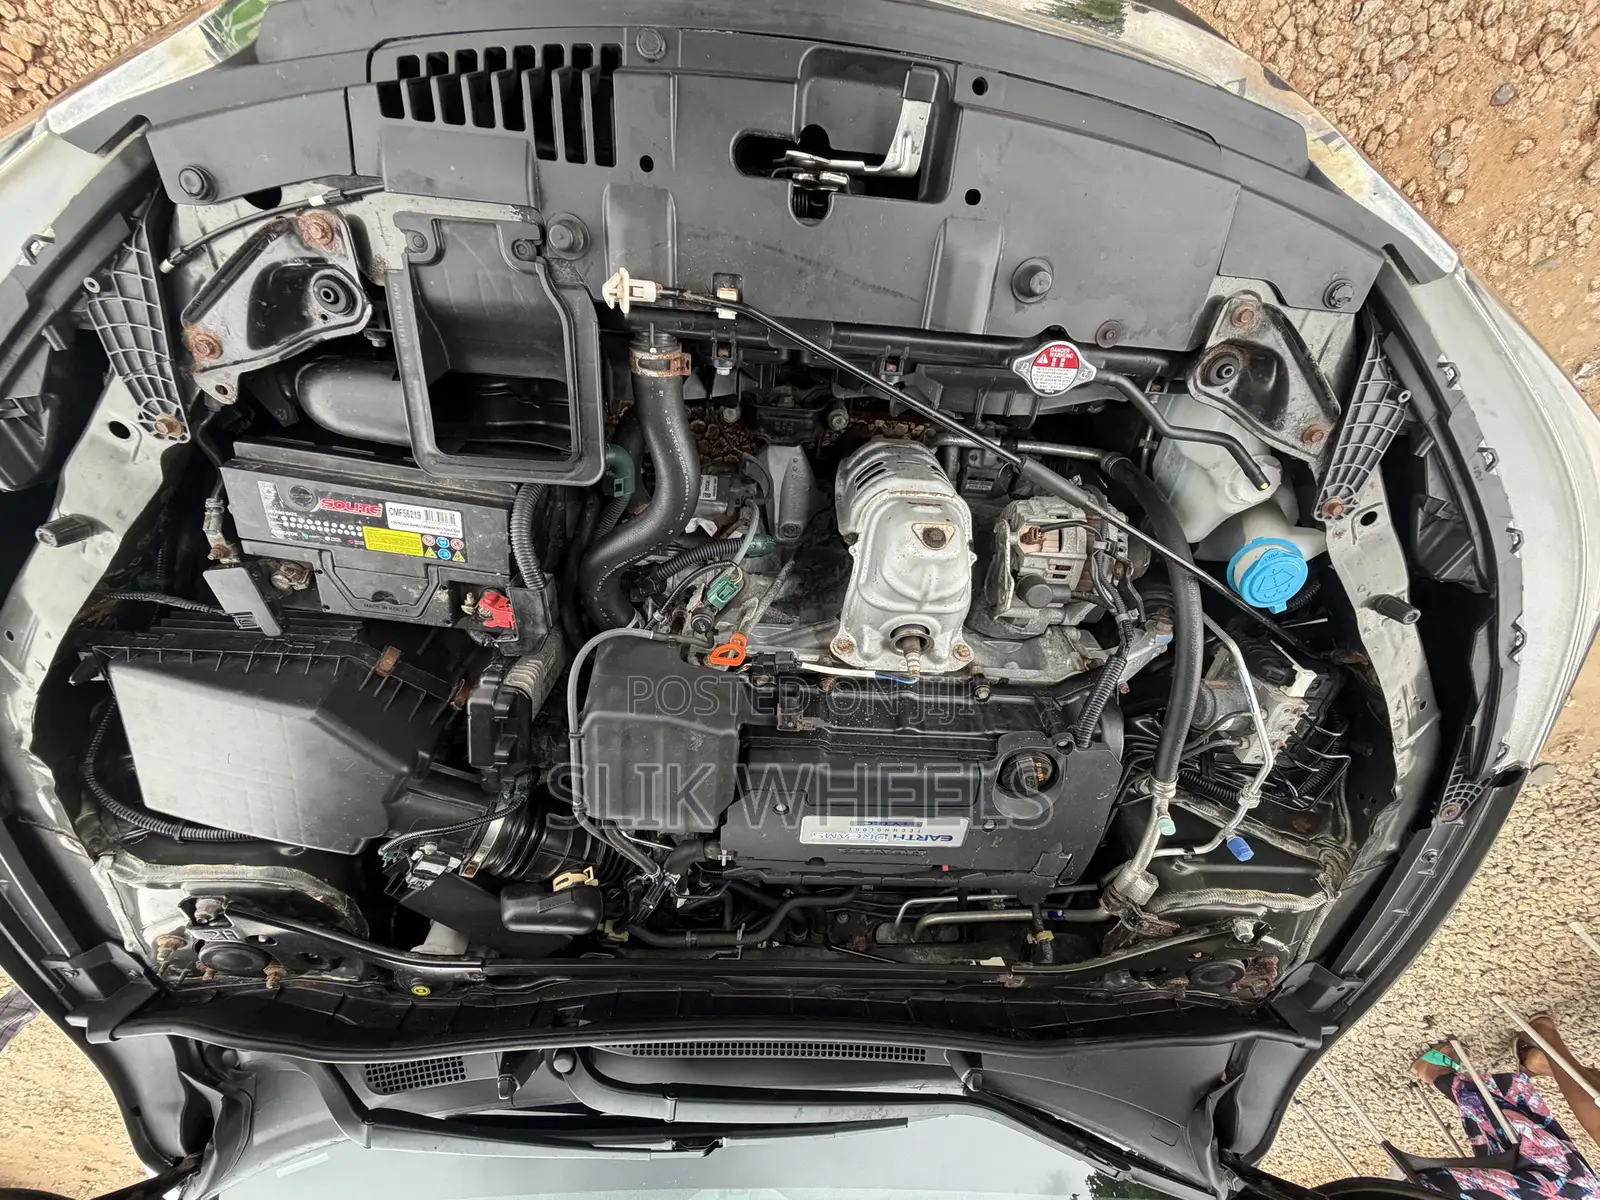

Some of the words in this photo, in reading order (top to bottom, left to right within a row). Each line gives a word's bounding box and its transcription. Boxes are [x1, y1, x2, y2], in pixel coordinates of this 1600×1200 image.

[320, 497, 382, 517] SOLITE
[388, 507, 422, 520] CMF56219
[811, 831, 889, 843] DREAMS
[892, 833, 954, 843] EARTH
